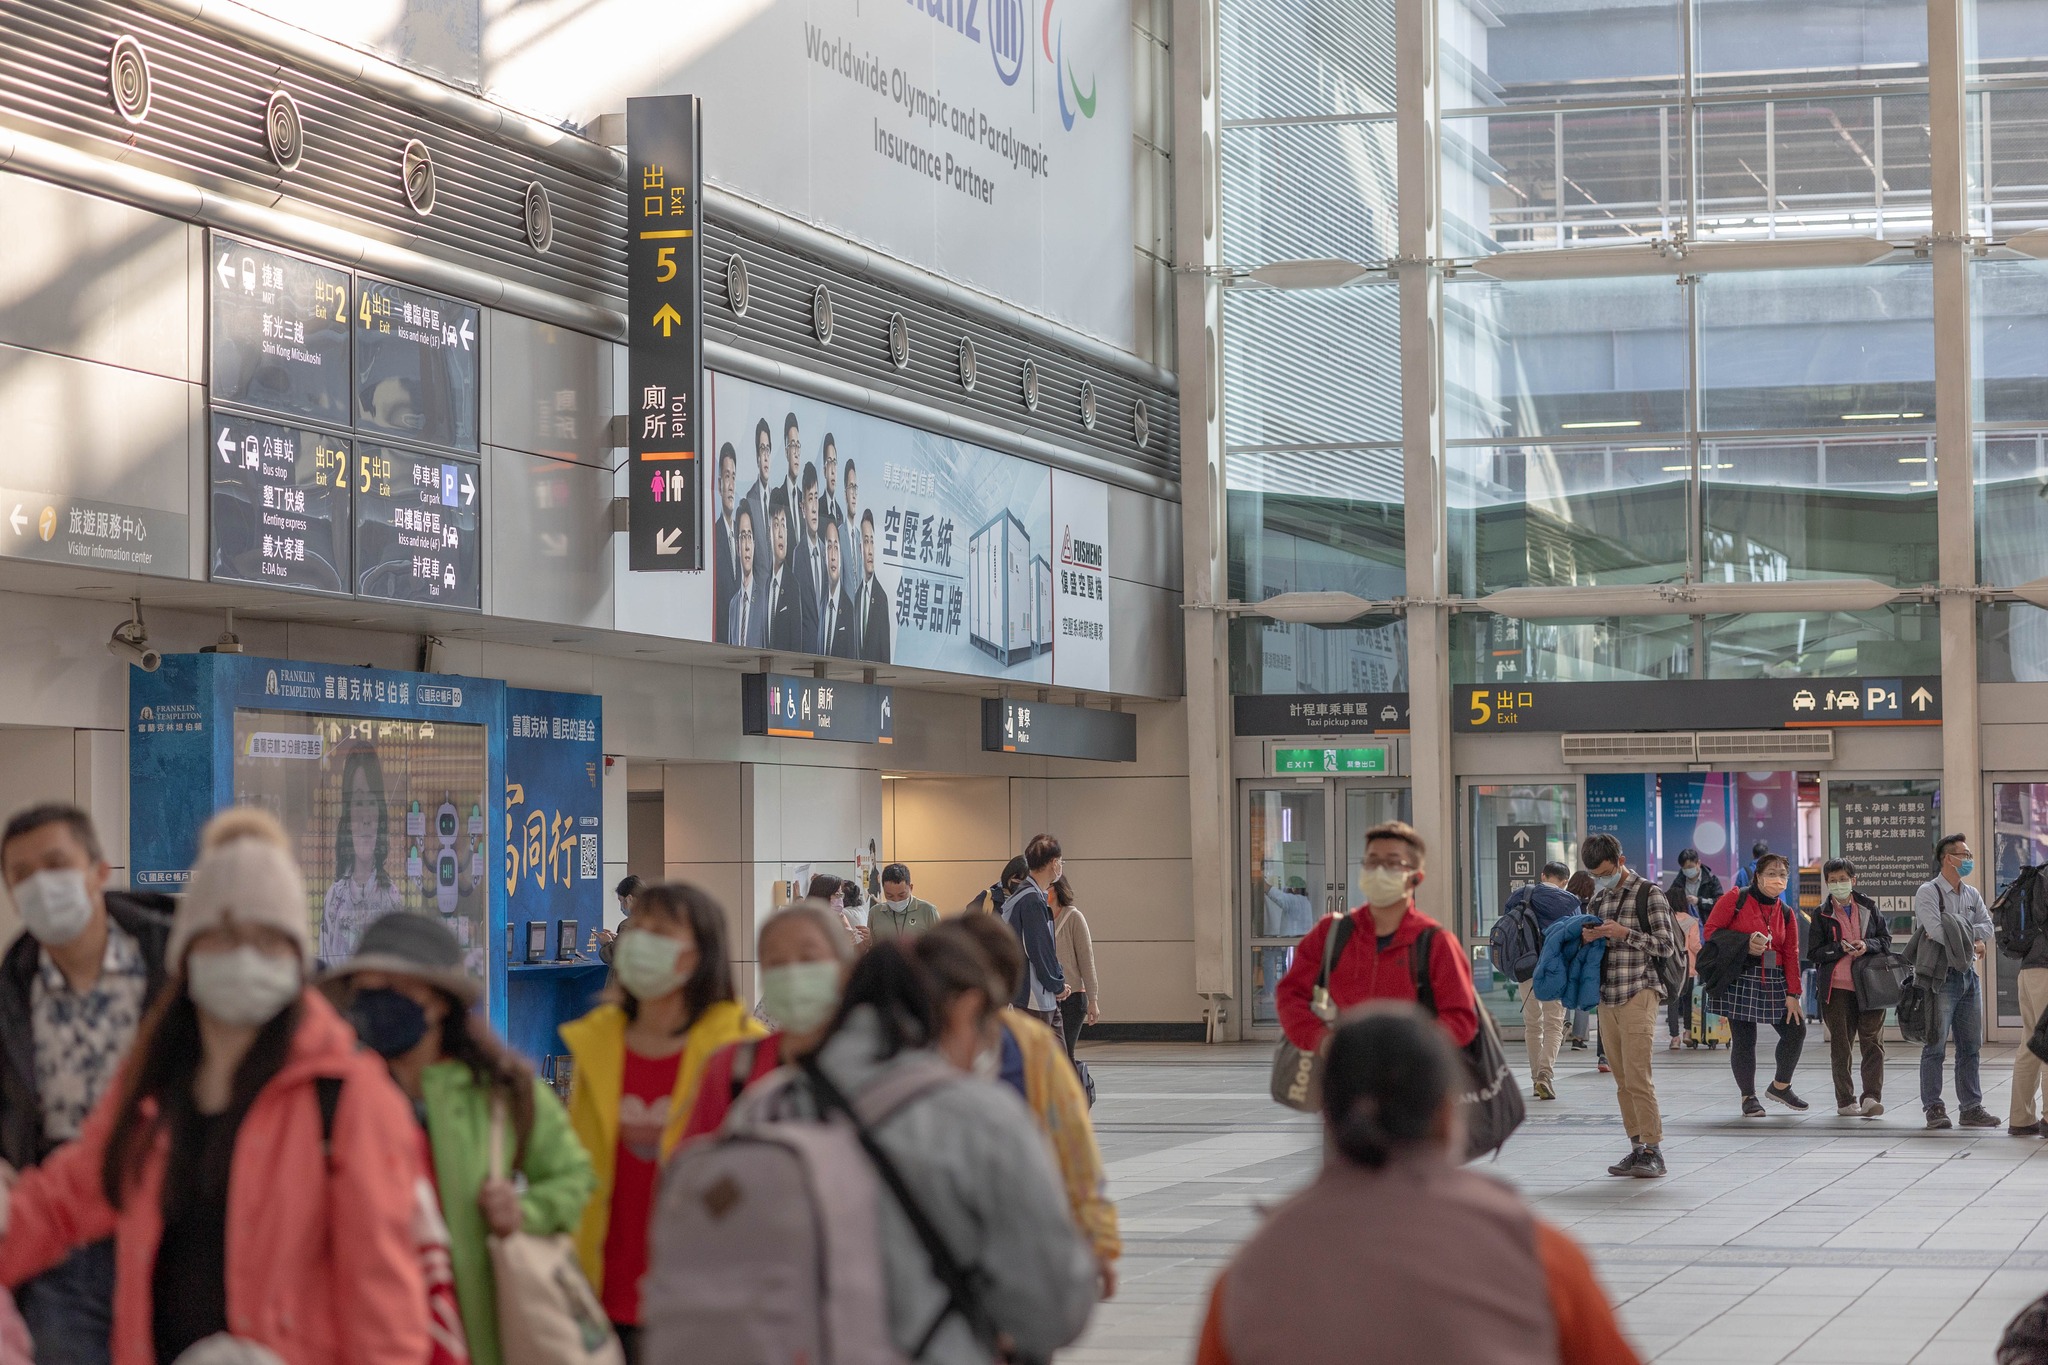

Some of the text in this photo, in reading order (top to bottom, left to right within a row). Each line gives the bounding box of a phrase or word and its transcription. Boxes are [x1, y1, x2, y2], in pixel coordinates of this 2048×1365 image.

[804, 21, 1049, 179] Worldwide Olympic and Paralympic
[874, 117, 995, 205] Insurance Partner
[643, 163, 664, 217] 出口
[670, 187, 685, 216] Exit
[262, 263, 283, 291] 捷運
[656, 247, 677, 283] 5
[262, 291, 275, 306] MRT
[315, 278, 347, 324] 出口 2
[359, 291, 391, 330] 4 出口
[315, 305, 327, 320] Exit
[394, 301, 440, 332] 一樓臨停區
[263, 313, 304, 345] 新光三越
[379, 320, 391, 335] Exit
[398, 325, 440, 349] kiss and ride (1F)
[263, 342, 321, 365] Shin Kong Mitsukoshi
[642, 384, 667, 439] 廁所
[672, 393, 687, 439] Toilet
[263, 436, 294, 463] 公車站
[263, 462, 288, 480] Bus stop
[315, 445, 347, 489] 出口 2
[316, 471, 327, 487] Exit
[360, 455, 391, 493] 5 出口
[412, 463, 440, 490] 停車場
[263, 484, 305, 514] 墾丁快線
[379, 482, 391, 497] Exit
[420, 490, 440, 507] Car park
[69, 506, 147, 542] 旅遊服務中心
[263, 513, 307, 532] Kenting express
[394, 507, 441, 535] 四樓臨停區
[262, 534, 304, 563] 義大客運
[398, 533, 441, 552] kiss and ride (4F)
[883, 506, 954, 568] 空壓系統
[68, 541, 153, 564] Visitor information center
[1073, 539, 1102, 567] FUSHENG
[262, 562, 288, 577] E-DA bus
[412, 555, 440, 581] 計程車
[429, 583, 440, 597] Taxi
[896, 576, 964, 636] 領導品牌
[281, 669, 315, 683] FRANKLIN
[281, 685, 321, 699] TEMPLETON
[324, 675, 409, 705] 富蘭克林坦伯頓
[817, 686, 834, 711] 廁所
[1867, 687, 1898, 711] P1
[1017, 707, 1031, 728] 警察
[1290, 702, 1369, 717] 計程車乘車區
[1470, 689, 1533, 725] 5 出口
[1497, 712, 1518, 724] Exit
[512, 714, 596, 741] 富蘭克林 國民的基金
[817, 713, 831, 728] Toilet
[1306, 718, 1368, 728] Taxi pickup area
[1017, 730, 1029, 743] Police
[1286, 761, 1315, 769] EXIT
[1845, 803, 1926, 813] 年長、孕婦、推嬰兒
[1845, 828, 1926, 839] 行動不便之旅客請改
[1846, 842, 1879, 852] 搭電梯。
[1890, 871, 1905, 879] large
[1906, 871, 1930, 879] luggage
